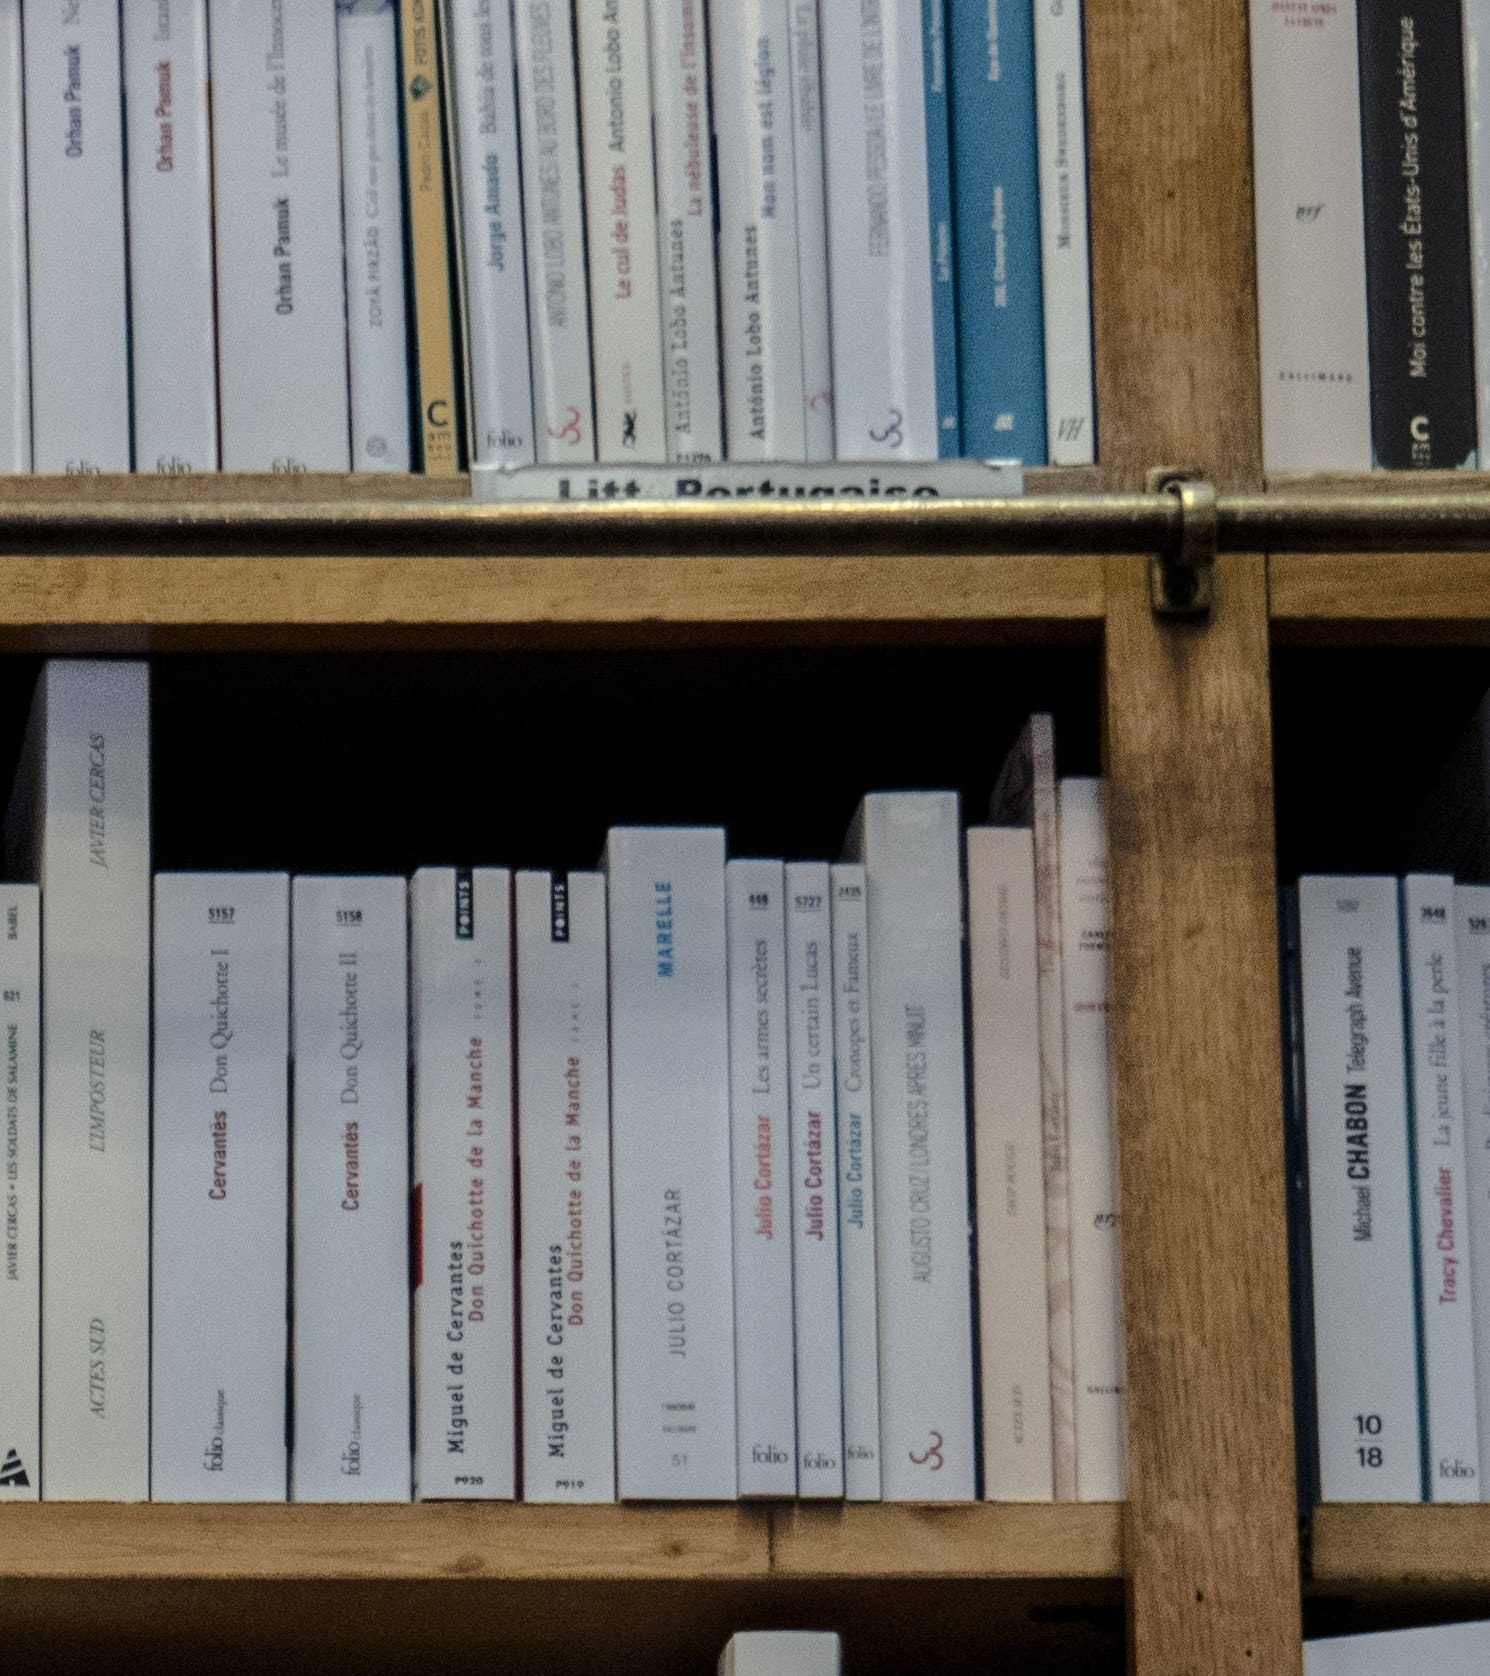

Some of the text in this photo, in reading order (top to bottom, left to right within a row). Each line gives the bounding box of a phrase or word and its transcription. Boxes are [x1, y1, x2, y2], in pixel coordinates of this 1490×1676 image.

[1397, 16, 1427, 379] Moi contre les États-Unis d'Amérique
[455, 878, 473, 938] POINTS
[655, 882, 673, 978] MARELLE
[1340, 947, 1372, 1242] Michael CHABON Telegraph Avenue
[445, 1241, 469, 1455] Miguel de Cervantes
[663, 1188, 687, 1358] JULIO CORTÁZAR
